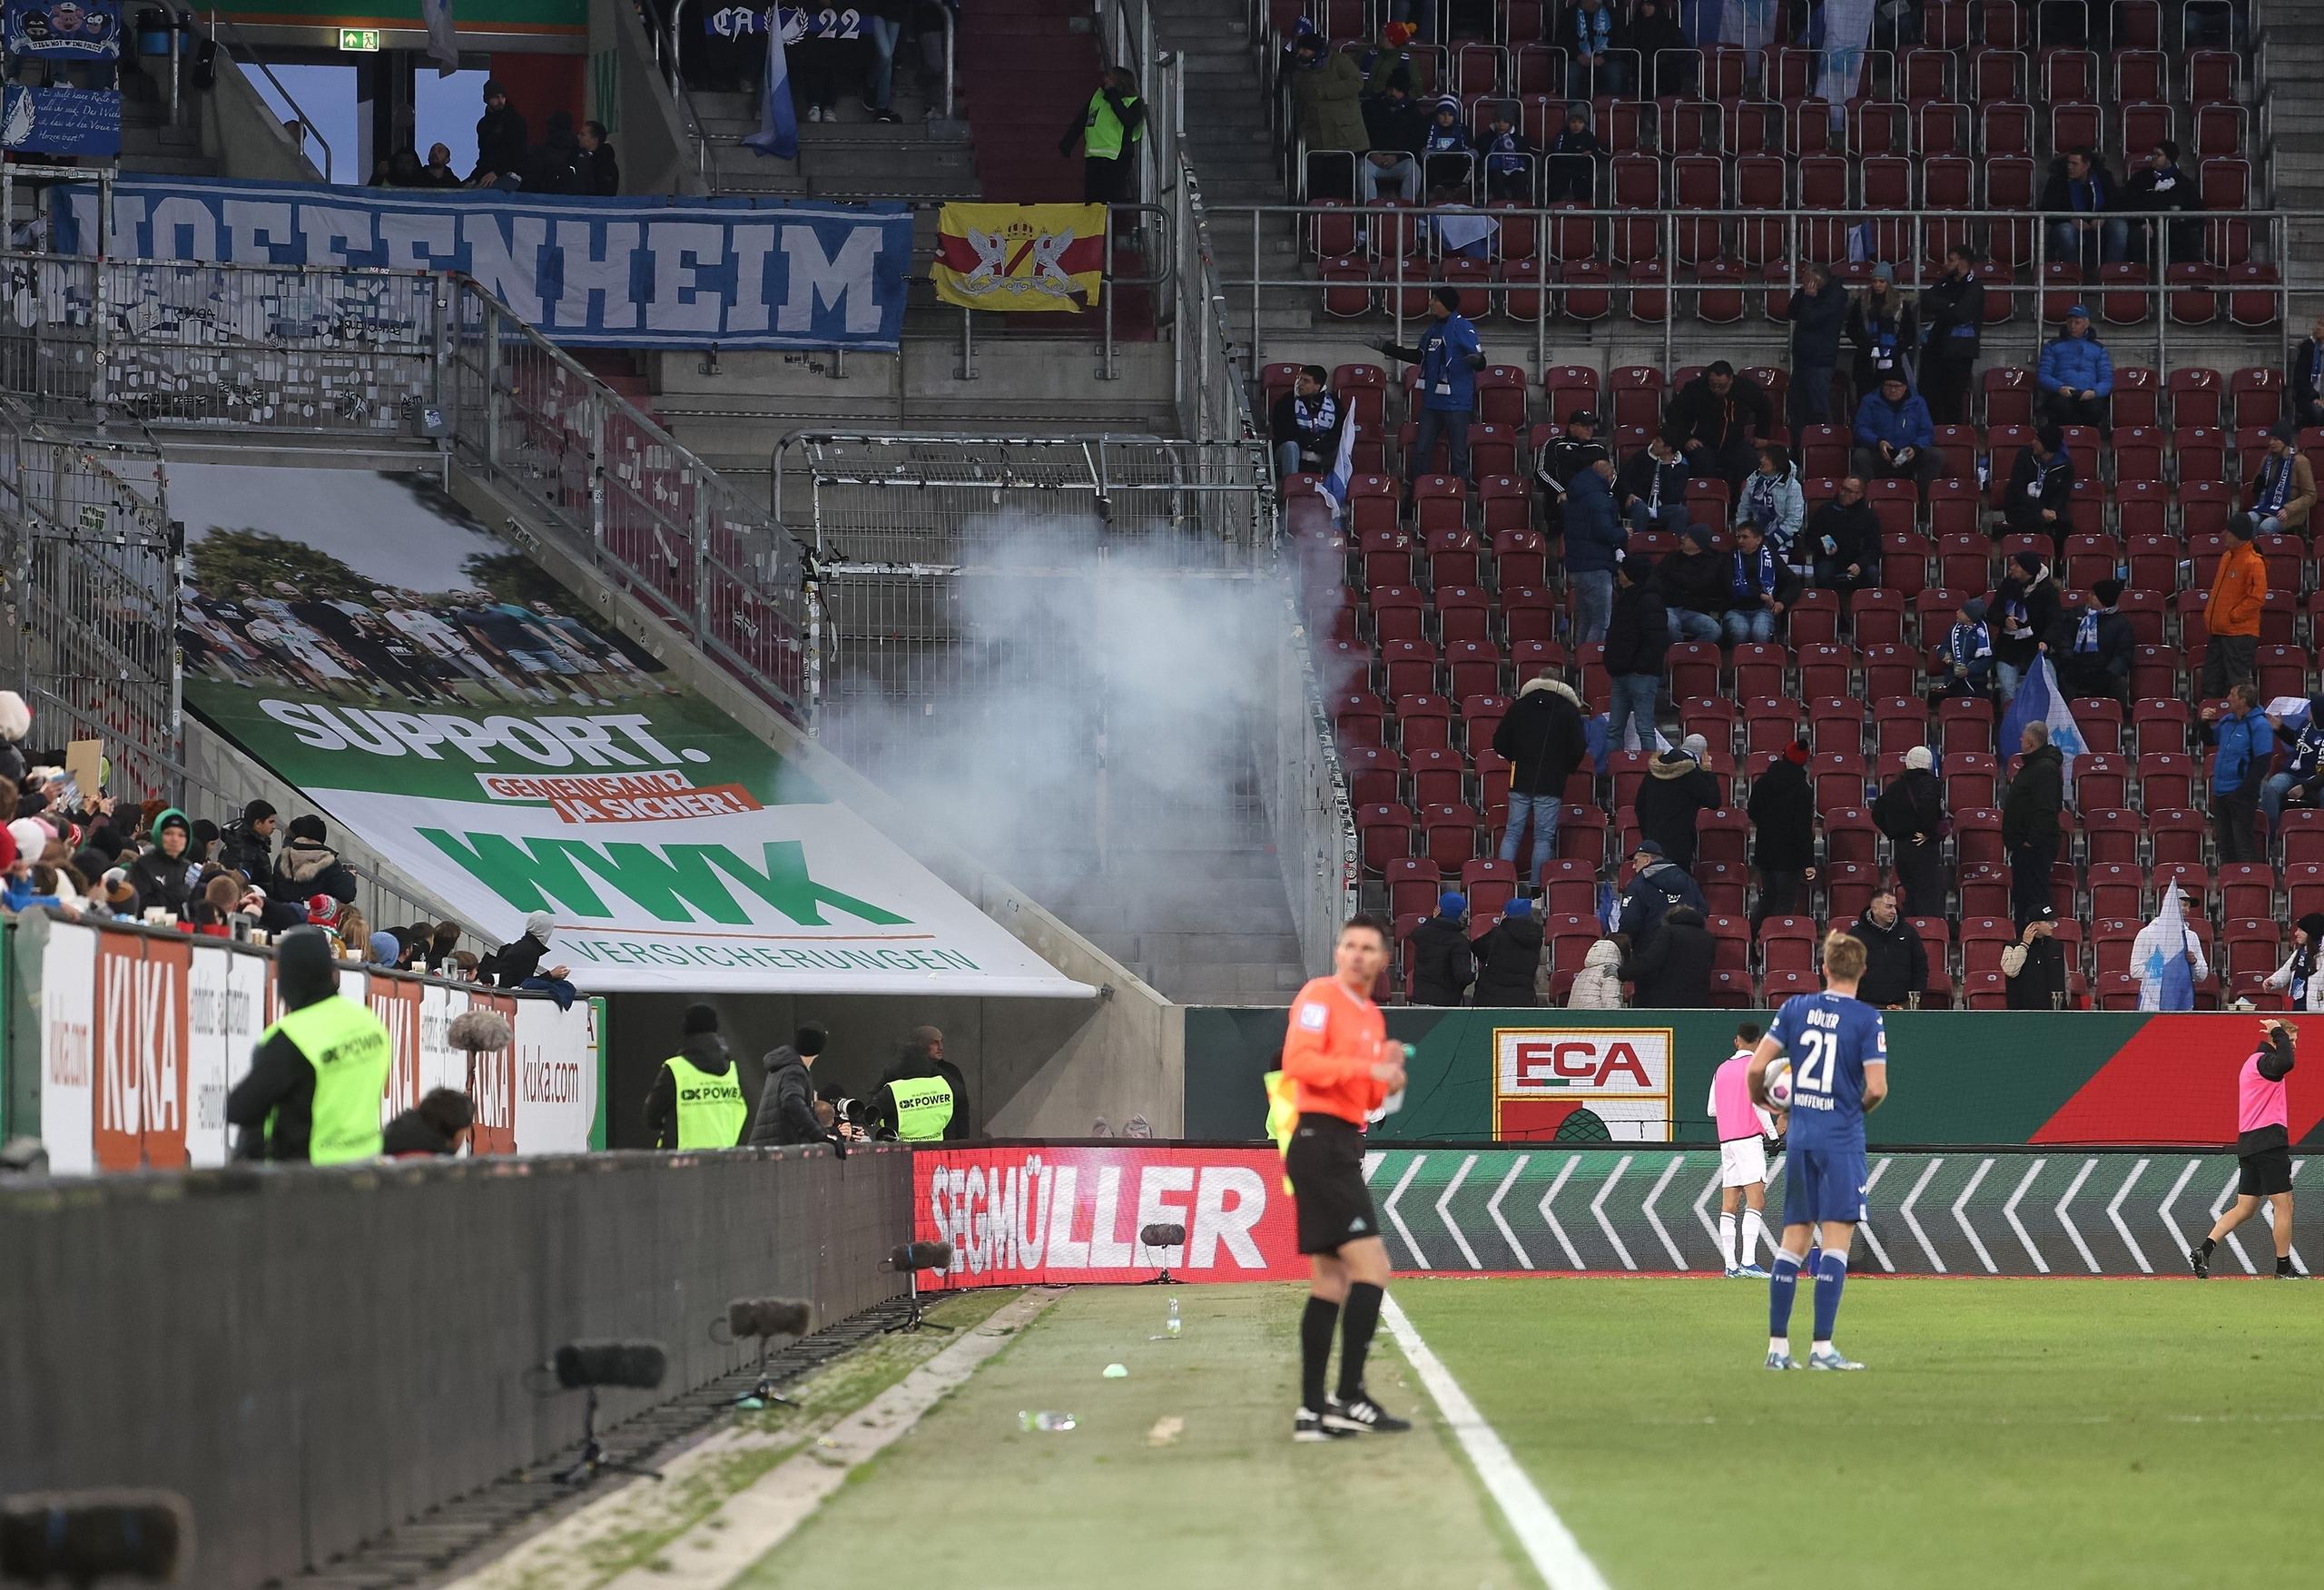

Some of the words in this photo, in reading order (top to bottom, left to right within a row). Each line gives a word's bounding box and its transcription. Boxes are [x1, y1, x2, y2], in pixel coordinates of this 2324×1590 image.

[817, 8, 861, 39] 22
[91, 91, 110, 104] Rolle
[70, 194, 882, 333] HOFFENHEIM
[258, 699, 711, 766] SUPPORT.
[487, 773, 684, 798] GEMEINSAM?
[556, 798, 601, 824] JA
[413, 827, 915, 926] WWK
[559, 940, 981, 971] VERSICHERUNGEN
[103, 953, 180, 1135] KUKA
[1517, 1042, 1652, 1087] FCA
[1797, 1029, 1838, 1094] 21
[523, 1044, 579, 1103] kuka.com
[915, 1093, 951, 1107] POWER
[931, 1154, 1267, 1278] SEGMÜLLER
